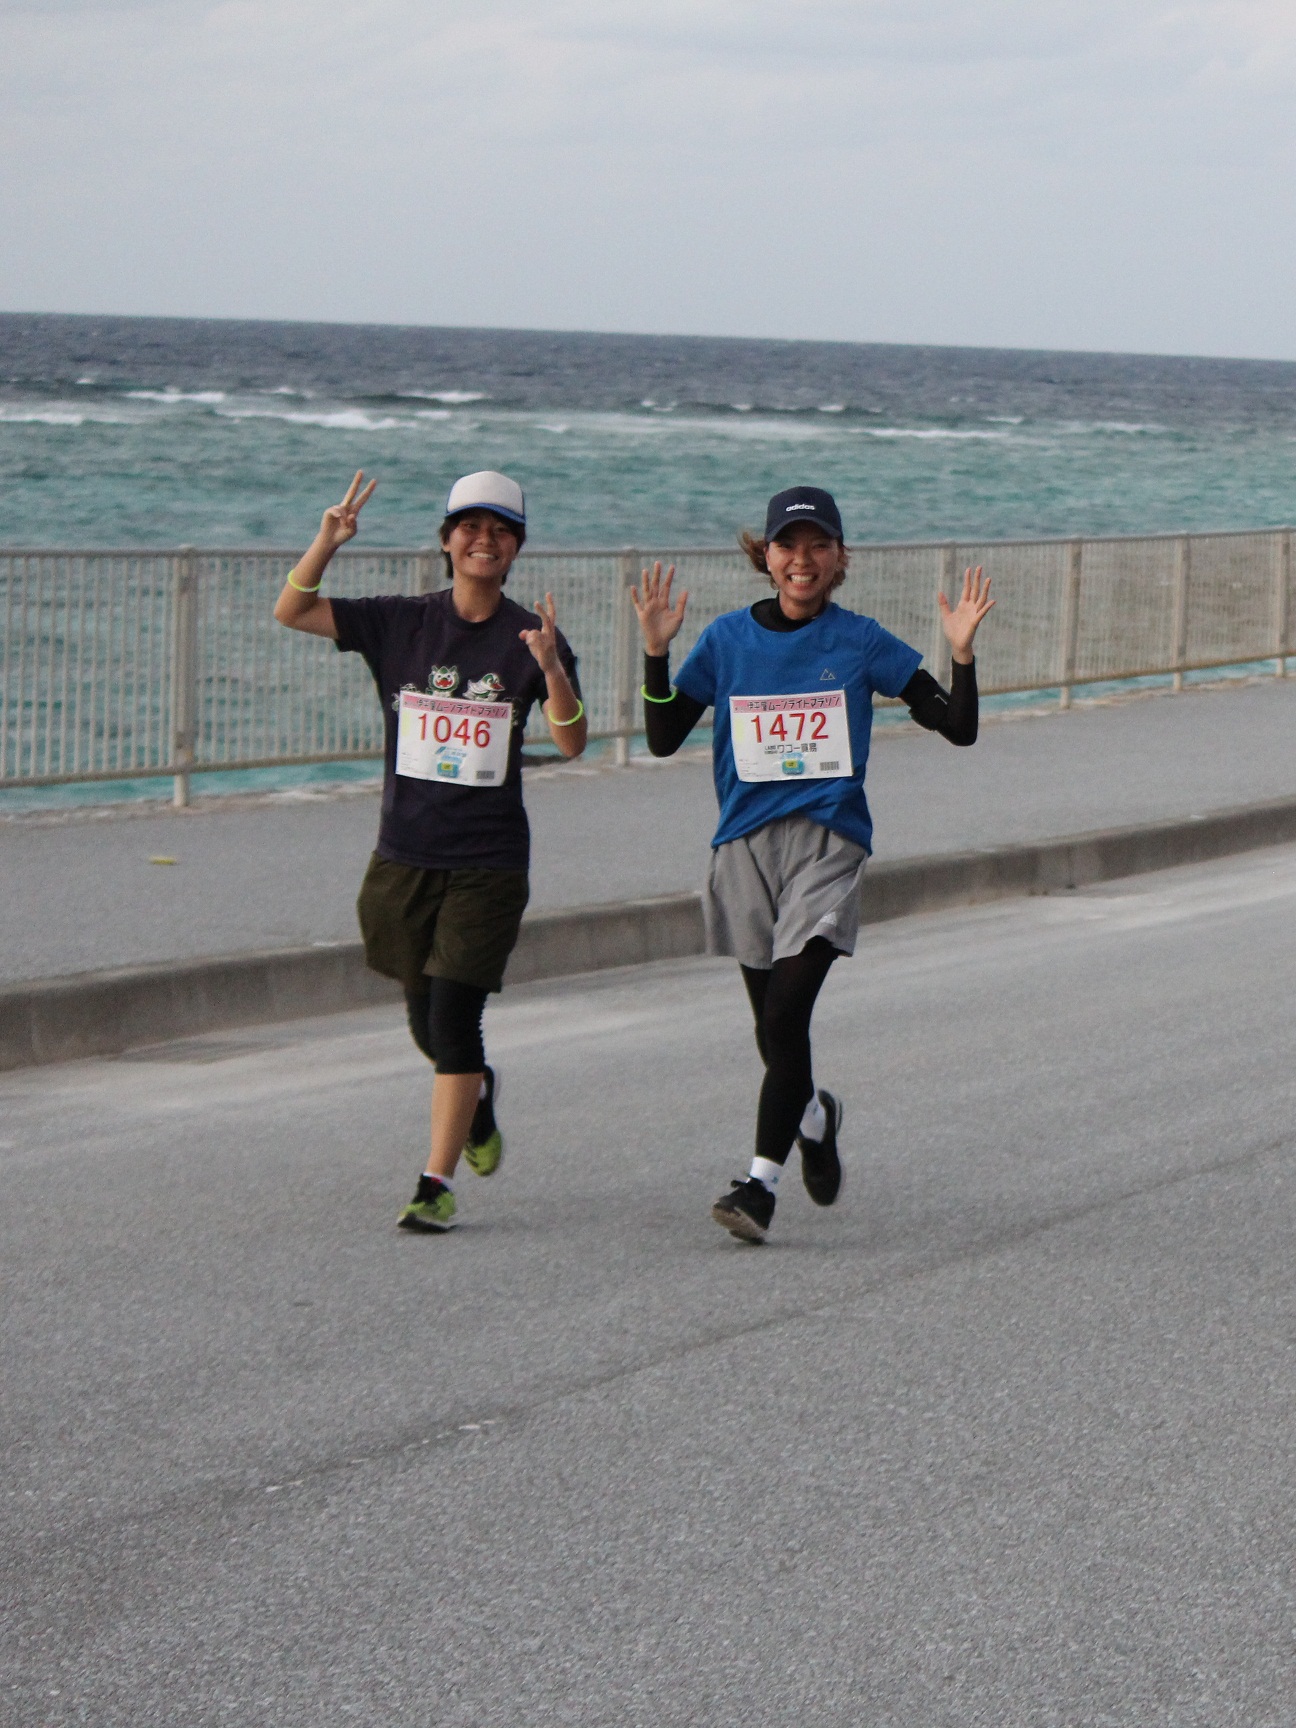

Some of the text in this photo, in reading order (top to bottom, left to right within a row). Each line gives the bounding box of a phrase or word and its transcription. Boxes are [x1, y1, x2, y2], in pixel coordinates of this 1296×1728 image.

[785, 503, 816, 512] adidas
[418, 713, 491, 749] 1046
[751, 711, 829, 743] 1472
